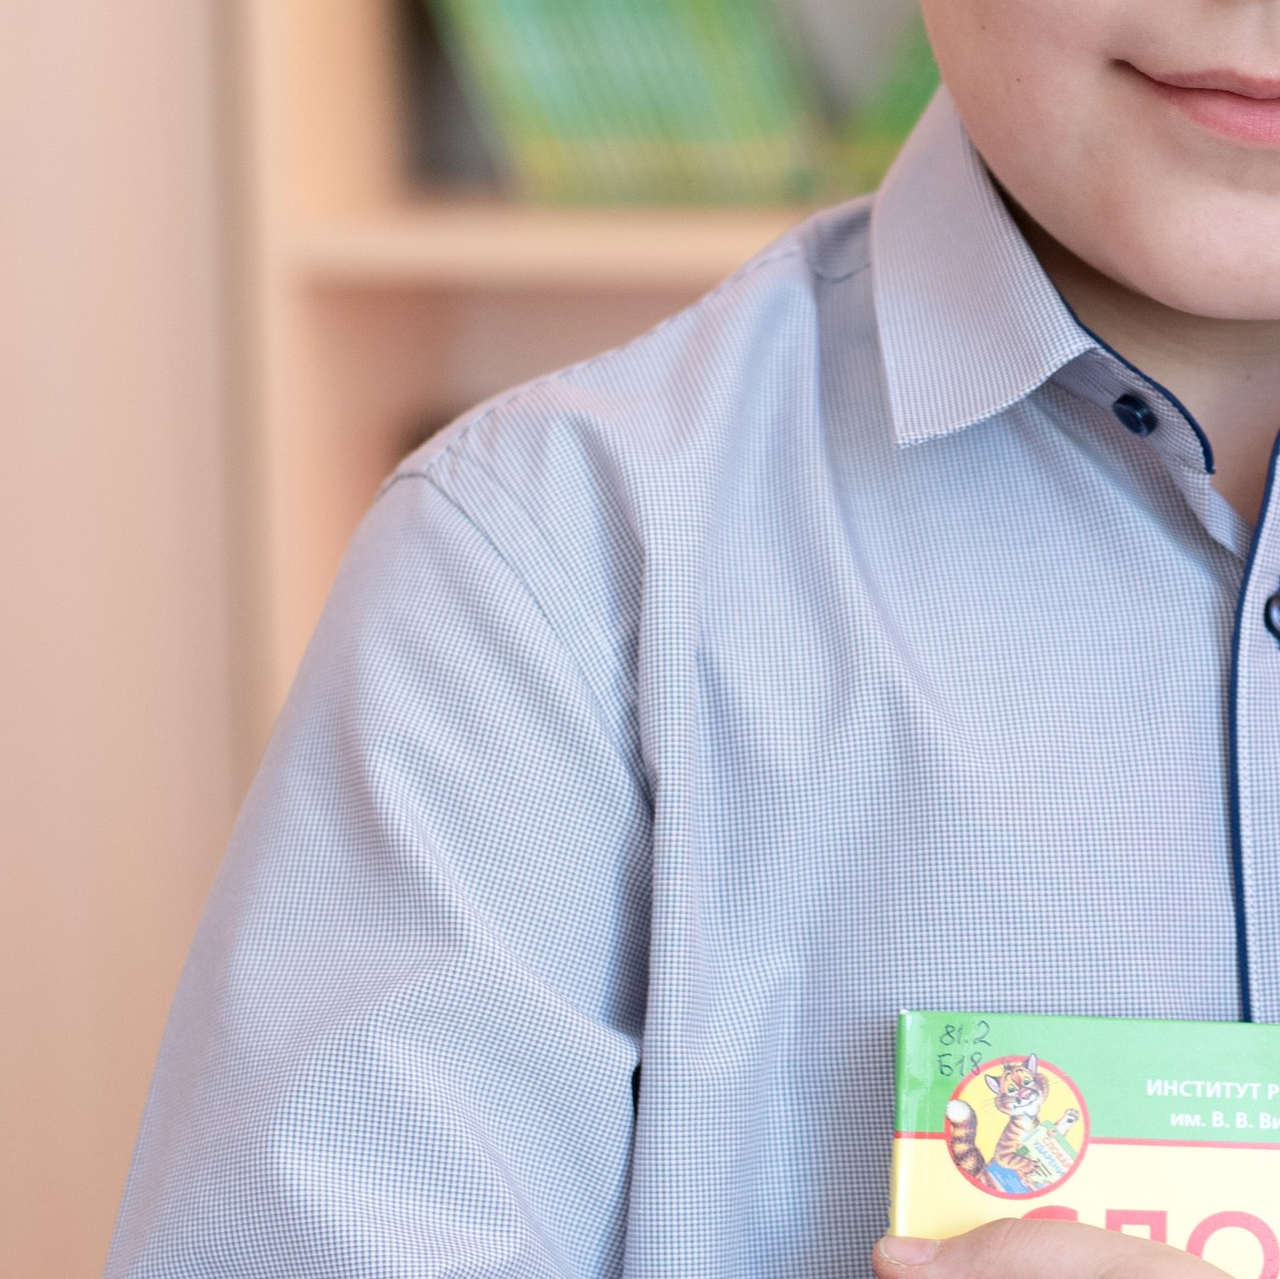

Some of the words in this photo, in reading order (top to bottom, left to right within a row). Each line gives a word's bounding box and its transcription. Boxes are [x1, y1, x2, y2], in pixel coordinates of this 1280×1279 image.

[939, 1020, 992, 1047] 81.2
[1146, 1079, 1262, 1100] ИНСТИТУТ
[1170, 1112, 1206, 1128] им.
[1212, 1111, 1231, 1129] В.
[1236, 1111, 1254, 1129] В.
